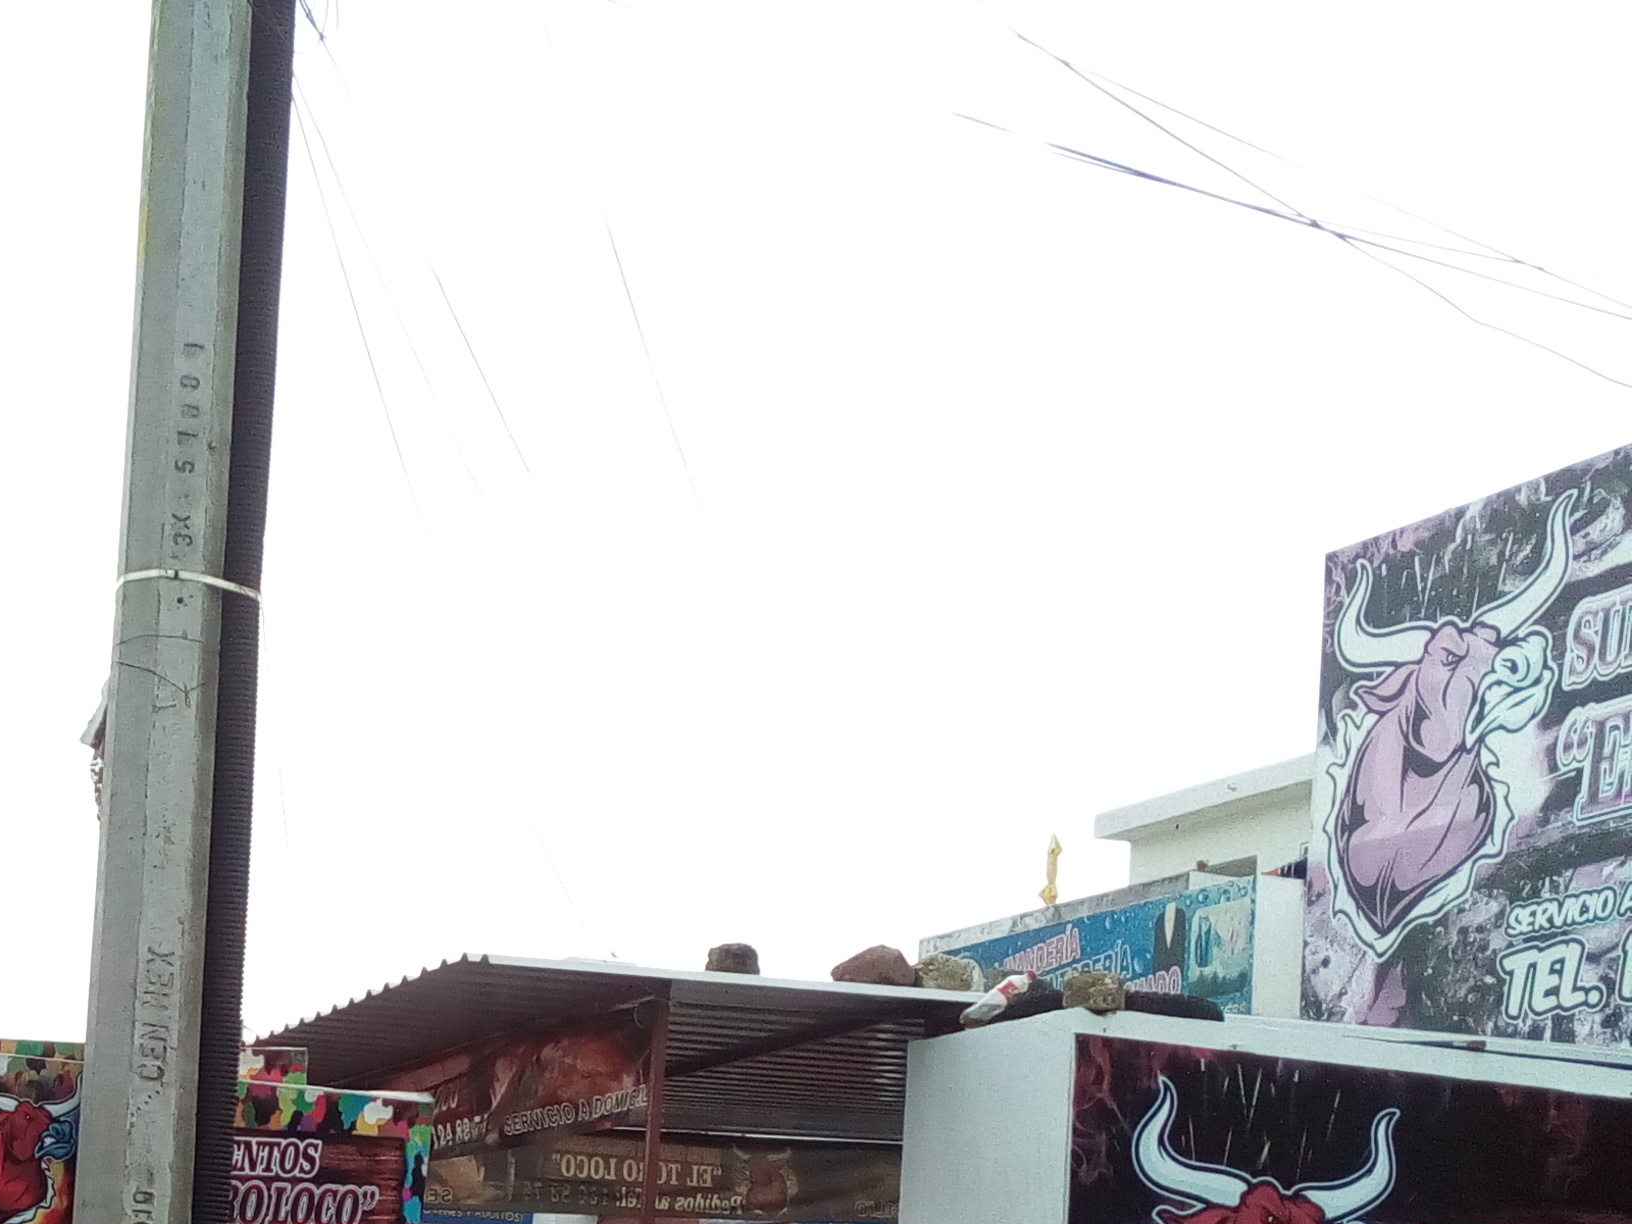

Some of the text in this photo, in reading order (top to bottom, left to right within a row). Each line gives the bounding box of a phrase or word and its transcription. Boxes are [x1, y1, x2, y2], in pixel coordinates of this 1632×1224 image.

[1563, 585, 1632, 691] SU
[1505, 886, 1617, 937] SERVICIO
[1497, 935, 1606, 1023] TEL.
[503, 1103, 576, 1136] SERVICIO
[578, 1099, 589, 1121] A
